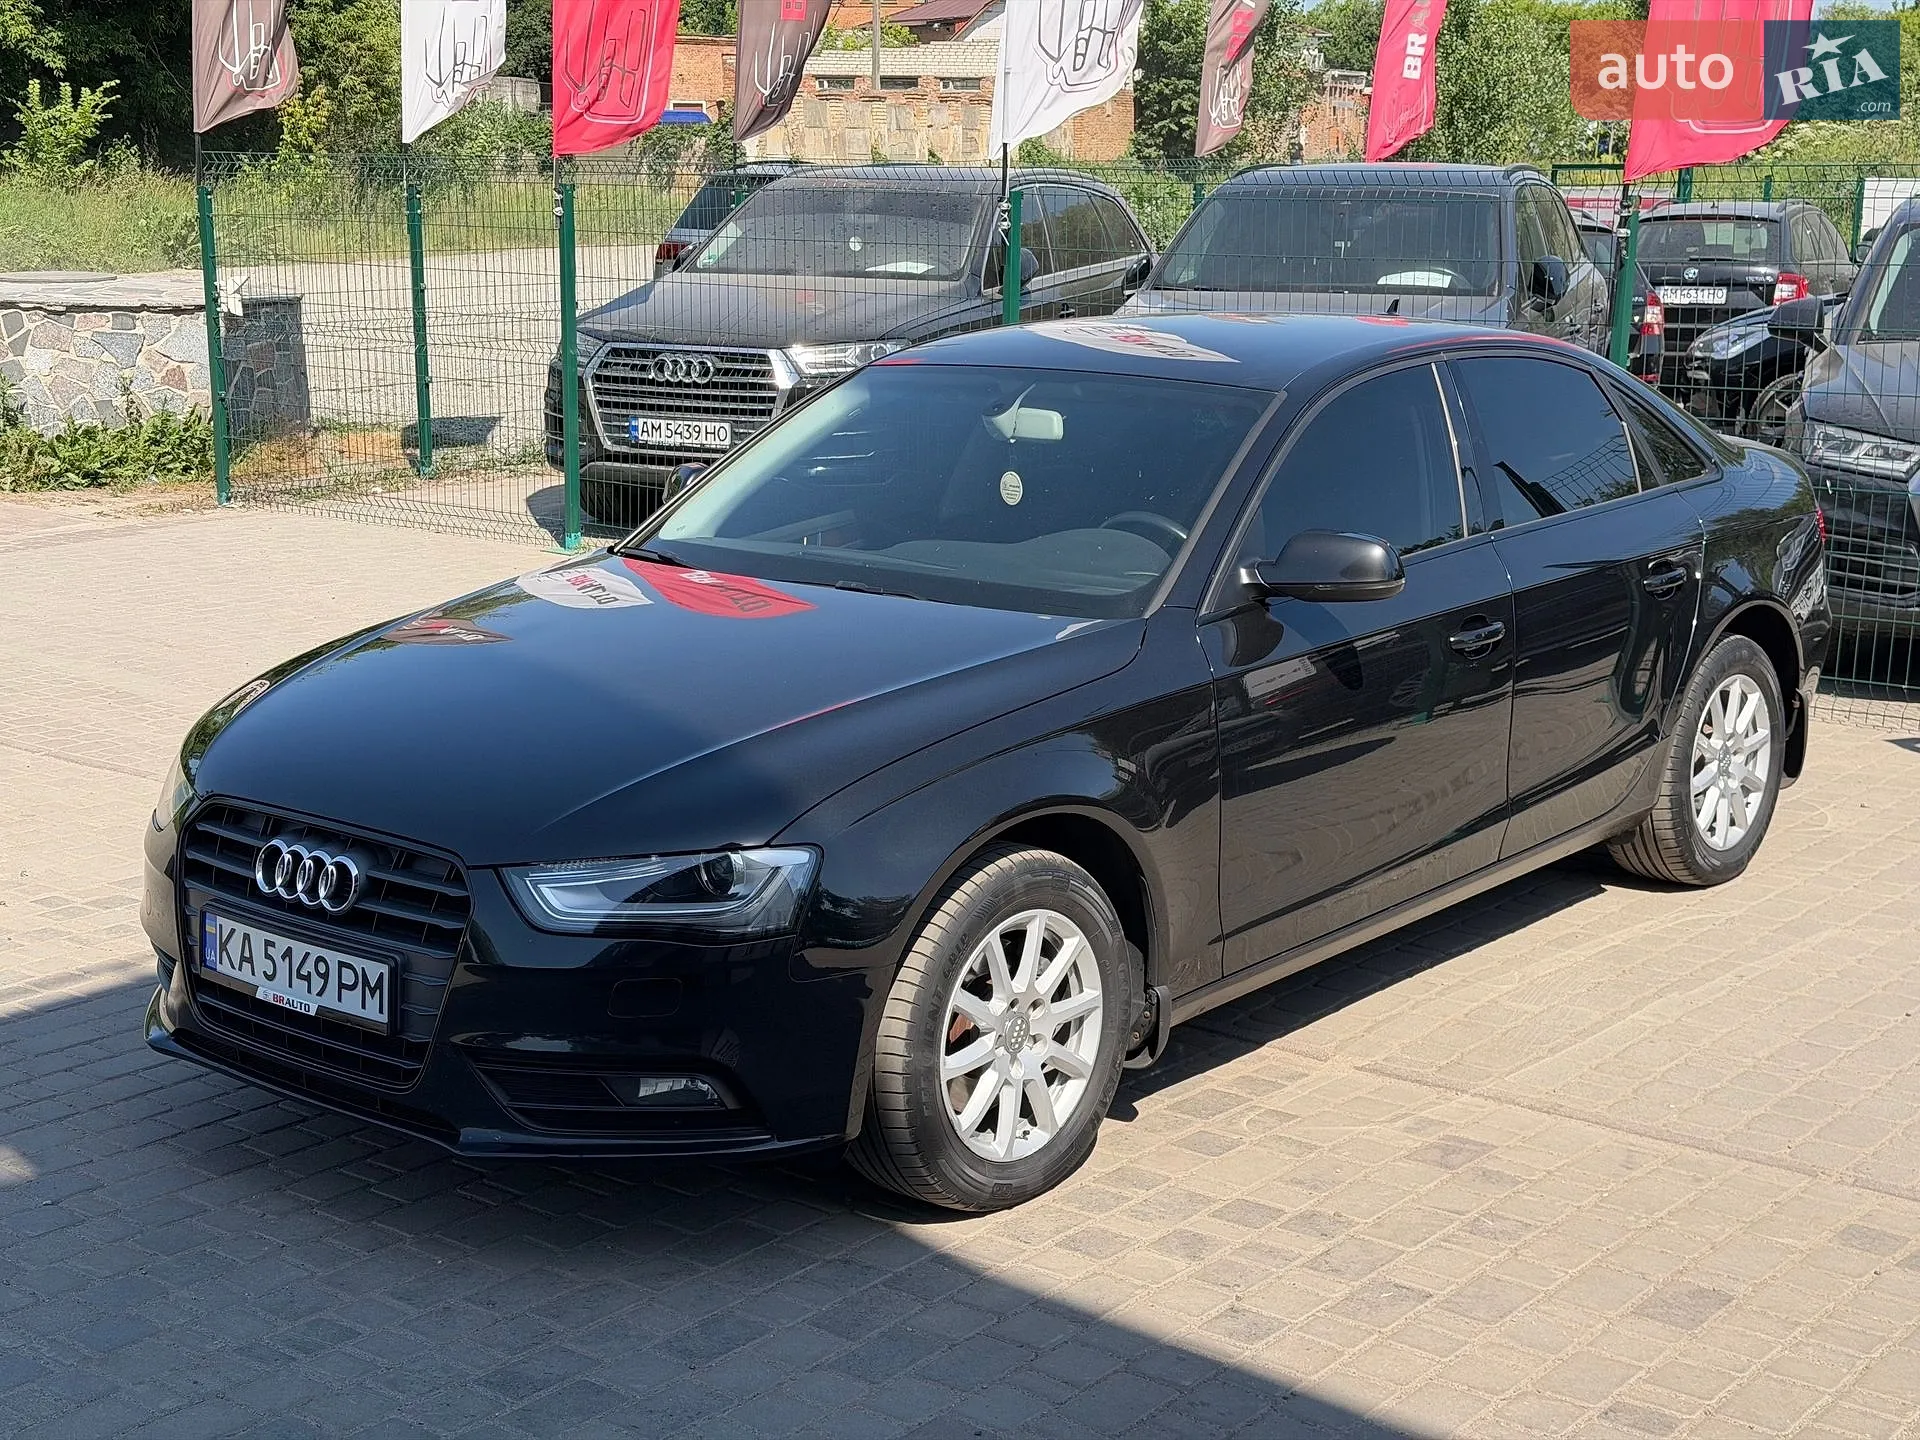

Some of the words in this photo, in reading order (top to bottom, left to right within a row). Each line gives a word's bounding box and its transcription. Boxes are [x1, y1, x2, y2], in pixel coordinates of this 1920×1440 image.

[640, 421, 662, 438] AM
[665, 422, 701, 440] 5439
[704, 424, 728, 442] HO
[205, 947, 216, 962] UA
[218, 923, 256, 977] KA
[262, 938, 330, 997] 5149
[337, 959, 384, 1015] PM
[272, 993, 311, 1013] BRAUTO
